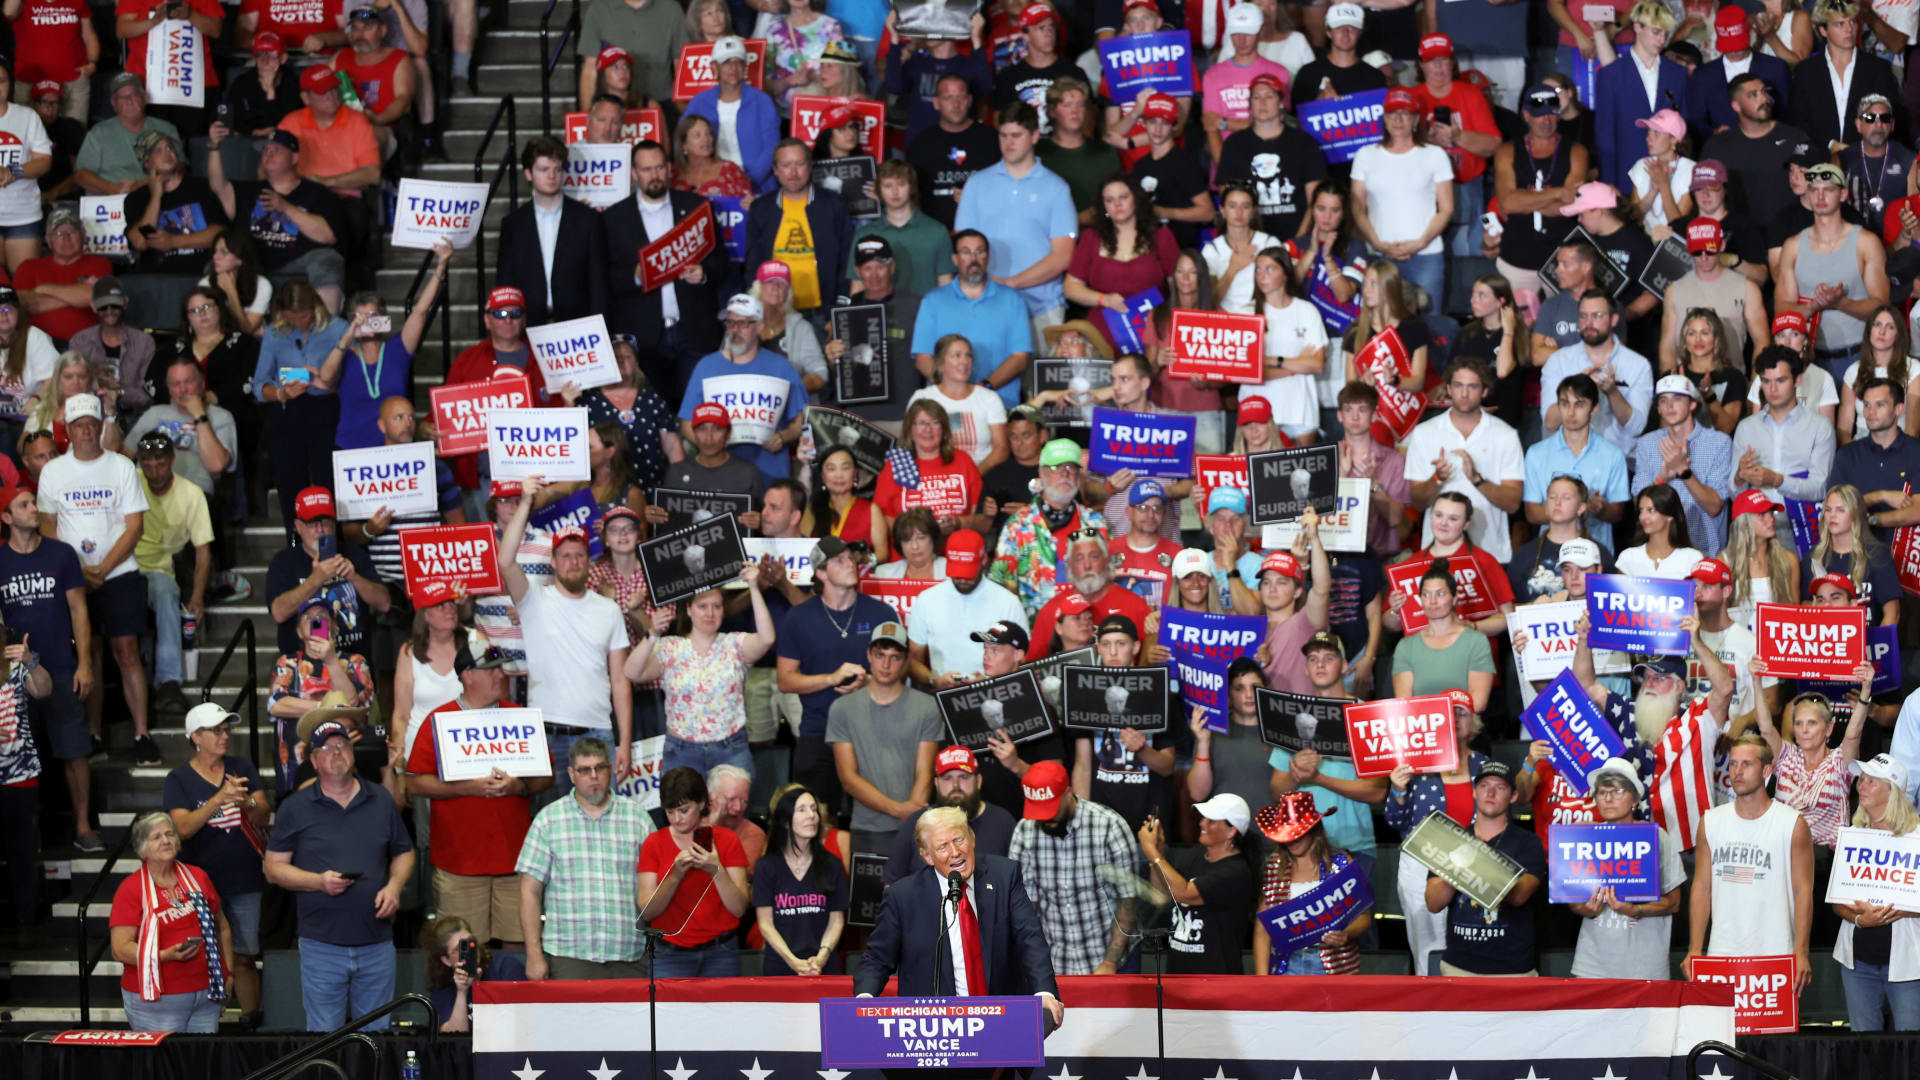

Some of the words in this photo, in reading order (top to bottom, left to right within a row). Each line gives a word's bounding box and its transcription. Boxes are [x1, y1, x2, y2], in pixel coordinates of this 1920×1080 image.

[271, 10, 324, 23] VOTES
[168, 30, 181, 88] VANCE
[181, 24, 194, 97] TRUMP
[1108, 45, 1185, 69] TRUMP
[1118, 62, 1179, 80] VANCE
[1307, 104, 1385, 131] TRUMP
[1320, 121, 1380, 142] VANCE
[564, 174, 614, 186] ANCE
[408, 197, 480, 214] TRUMP
[415, 213, 471, 228] VANCE
[648, 216, 709, 269] TRUMP
[657, 234, 705, 273] VANCE
[536, 333, 600, 358] TRUMP
[1178, 326, 1257, 347] TRUMP
[547, 351, 599, 371] VANCE
[1185, 343, 1248, 361] VANCE
[440, 392, 525, 419] TRUMP
[728, 408, 776, 424] ANCE
[495, 427, 579, 442] TRUMP
[1100, 422, 1187, 445] TRUMP
[505, 444, 571, 457] VANCE
[1109, 440, 1176, 457] VANCE
[343, 460, 426, 482] TRUMP
[1263, 455, 1328, 478] NEVER
[64, 489, 113, 501] TRUMP
[354, 477, 419, 496] VANCE
[407, 539, 489, 561] TRUMP
[654, 525, 726, 562] NEVER
[418, 556, 483, 575] VANCE
[0, 576, 56, 599] TRUMP
[656, 560, 744, 598] SURRENDER
[1593, 591, 1685, 613] TRUMP
[1527, 620, 1577, 640] TRU
[1602, 611, 1674, 629] VANCE
[1167, 622, 1257, 647] TRUMP
[1765, 620, 1858, 642] TRUMP
[1540, 638, 1579, 654] VAN
[1627, 643, 1646, 651] 2024
[1775, 639, 1848, 657] VANCE
[1077, 673, 1154, 692] NEVER
[1178, 662, 1224, 692] TRUMP
[953, 681, 1024, 713] NEVER
[1070, 710, 1163, 725] SURRENDER
[1269, 697, 1342, 721] NEVER
[1353, 712, 1446, 739] TRUMP
[1551, 684, 1611, 761] TRUMP
[448, 724, 536, 743] TRUMP
[1365, 732, 1438, 753] VANCE
[1546, 706, 1593, 768] VANCE
[460, 741, 530, 756] VANCE
[1023, 784, 1055, 800] MAGA
[1558, 841, 1651, 861] TRUMP
[1711, 846, 1772, 870] AMERICA
[1420, 841, 1490, 895] NEVER
[1570, 861, 1642, 876] VANCE
[1849, 865, 1917, 885] VANCE
[775, 893, 826, 908] Women
[1271, 877, 1357, 930] TRUMP
[157, 900, 196, 925] TRUM
[779, 908, 794, 916] FOR
[796, 906, 820, 915] TRUMP
[1289, 895, 1357, 936] VANCE
[1453, 925, 1478, 937] TRUMP
[1480, 928, 1505, 937] 2024
[860, 1007, 888, 1016] TEXT
[891, 1006, 947, 1016] MICHIGAN
[949, 1007, 965, 1015] TO
[967, 1006, 1002, 1016] 88022
[877, 1017, 985, 1039] TRUMP
[903, 1038, 960, 1052] VANCE
[917, 1057, 949, 1067] 2024
